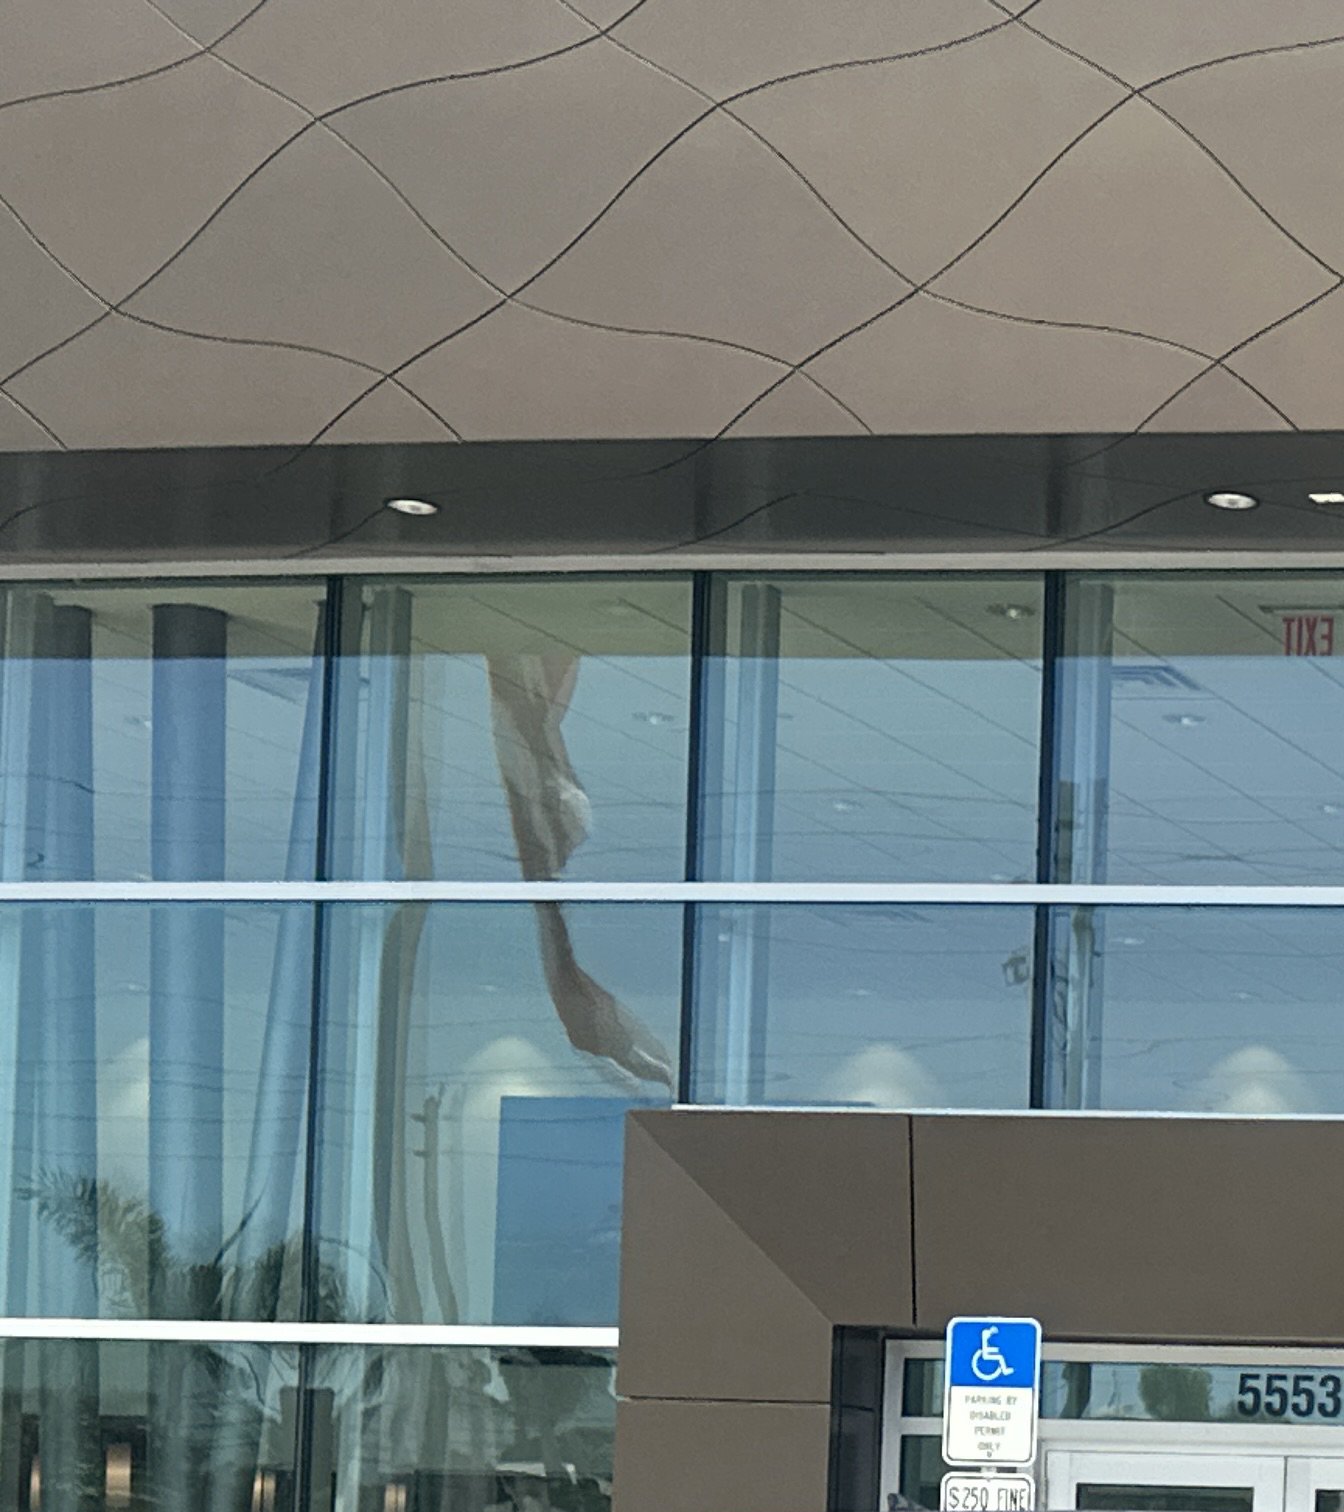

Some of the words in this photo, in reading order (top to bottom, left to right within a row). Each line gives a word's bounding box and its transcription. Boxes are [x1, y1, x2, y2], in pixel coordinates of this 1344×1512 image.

[965, 1395, 1001, 1404] PARKING
[1006, 1396, 1017, 1405] BY
[1237, 1373, 1342, 1417] 5553
[969, 1411, 1011, 1420] DISABLED
[998, 1488, 1026, 1511] FINE
